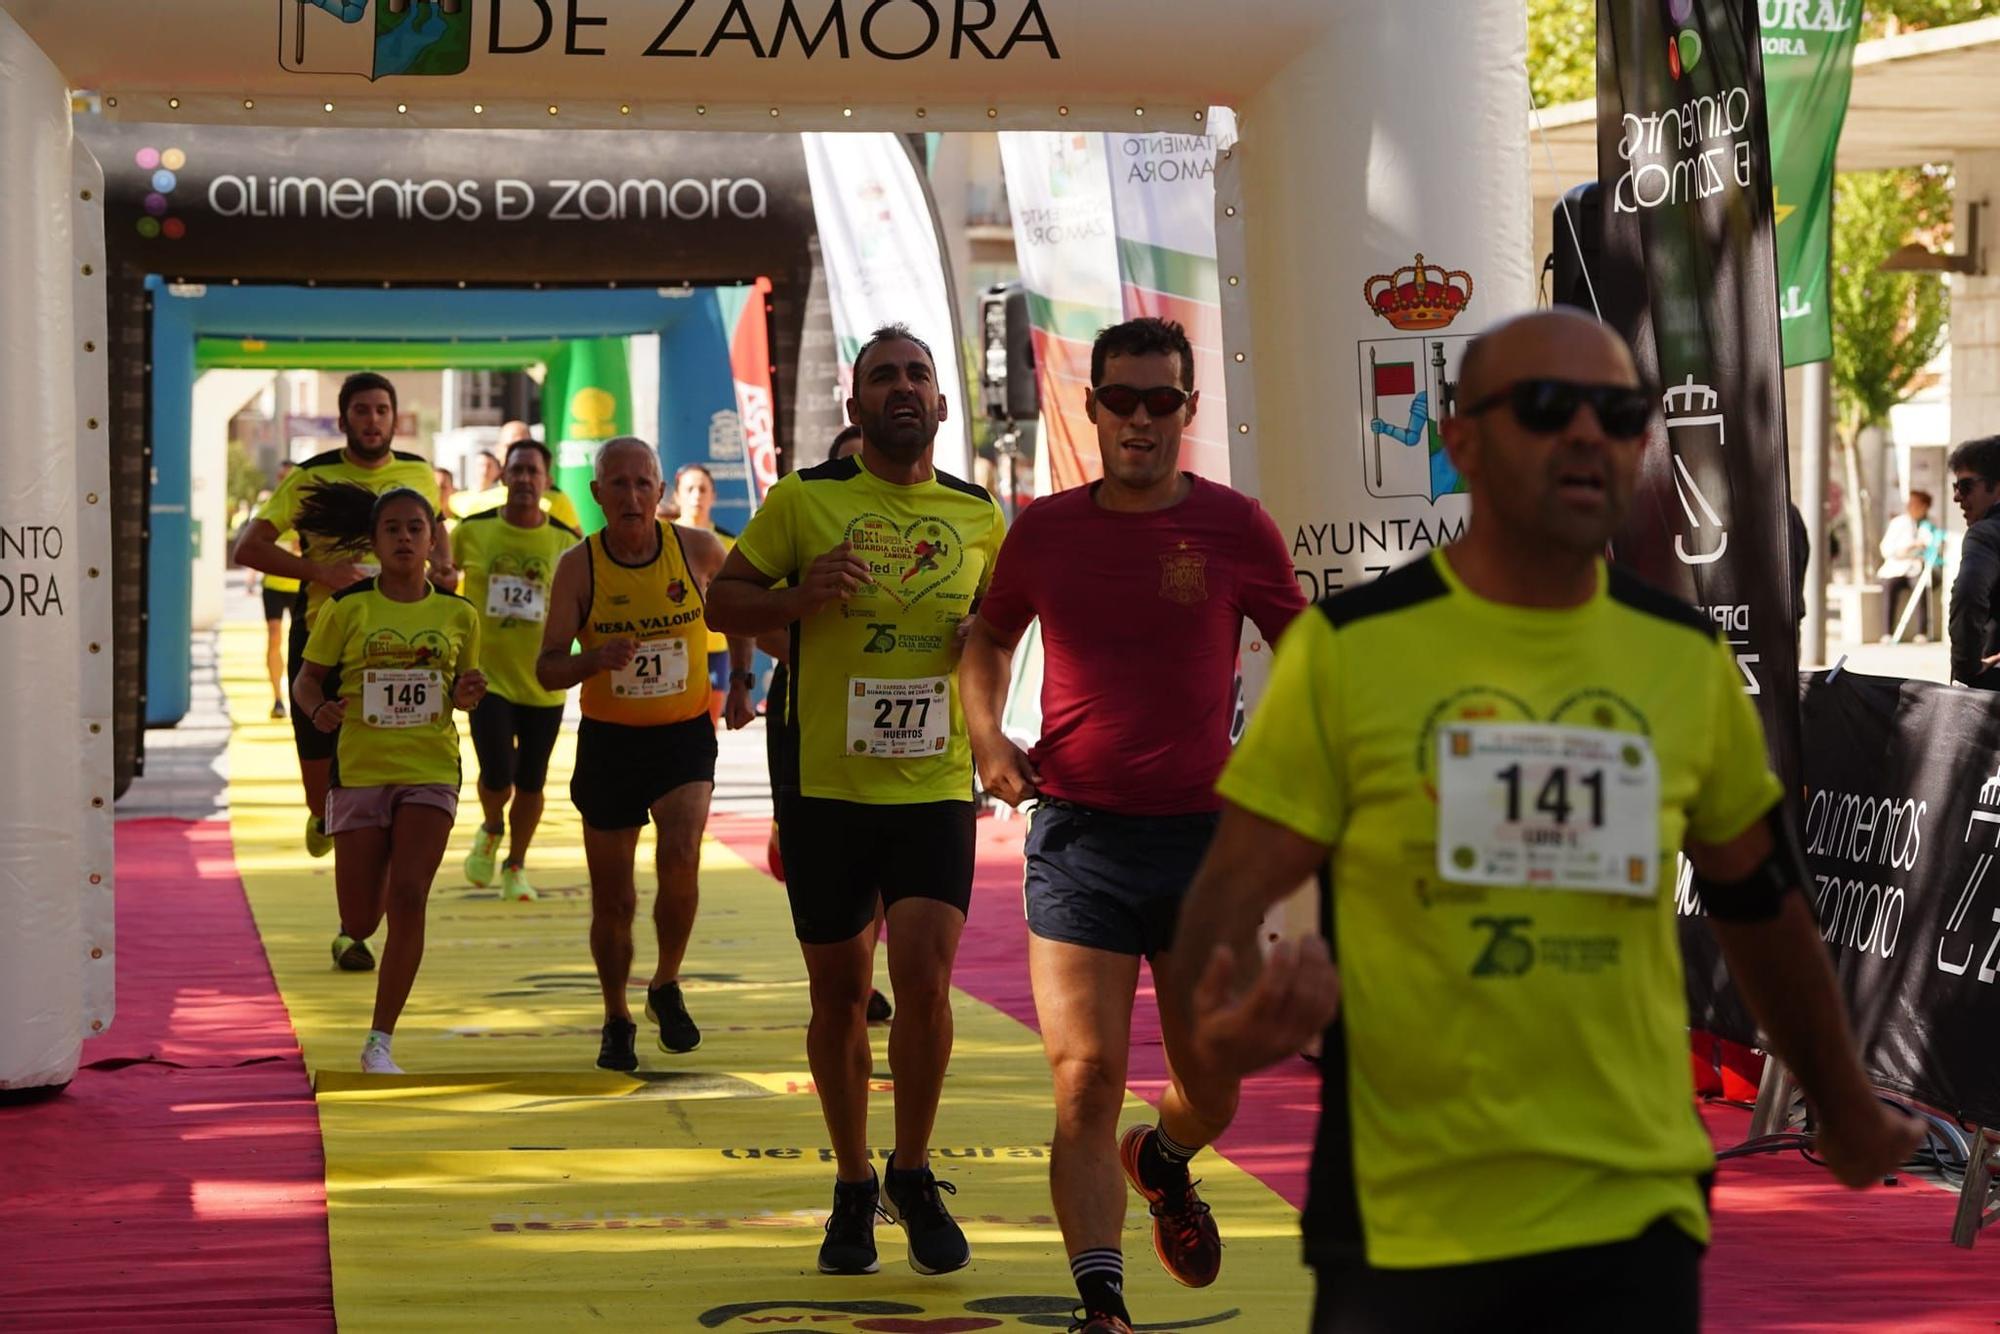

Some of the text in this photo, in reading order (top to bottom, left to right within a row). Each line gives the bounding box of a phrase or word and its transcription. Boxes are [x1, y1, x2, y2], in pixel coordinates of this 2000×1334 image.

[487, 0, 1061, 60] DE ZAMORA
[1761, 37, 1807, 56] ORA
[547, 177, 767, 220] zamora
[0, 526, 63, 559] NTO
[1293, 517, 1465, 556] AYUNTAM
[503, 586, 533, 605] 124
[594, 608, 701, 633] MESA VALORIO
[634, 654, 662, 678] 21
[383, 683, 426, 706] 146
[873, 698, 931, 729] 277
[883, 729, 923, 739] HUERTOS
[1496, 762, 1606, 828] 141
